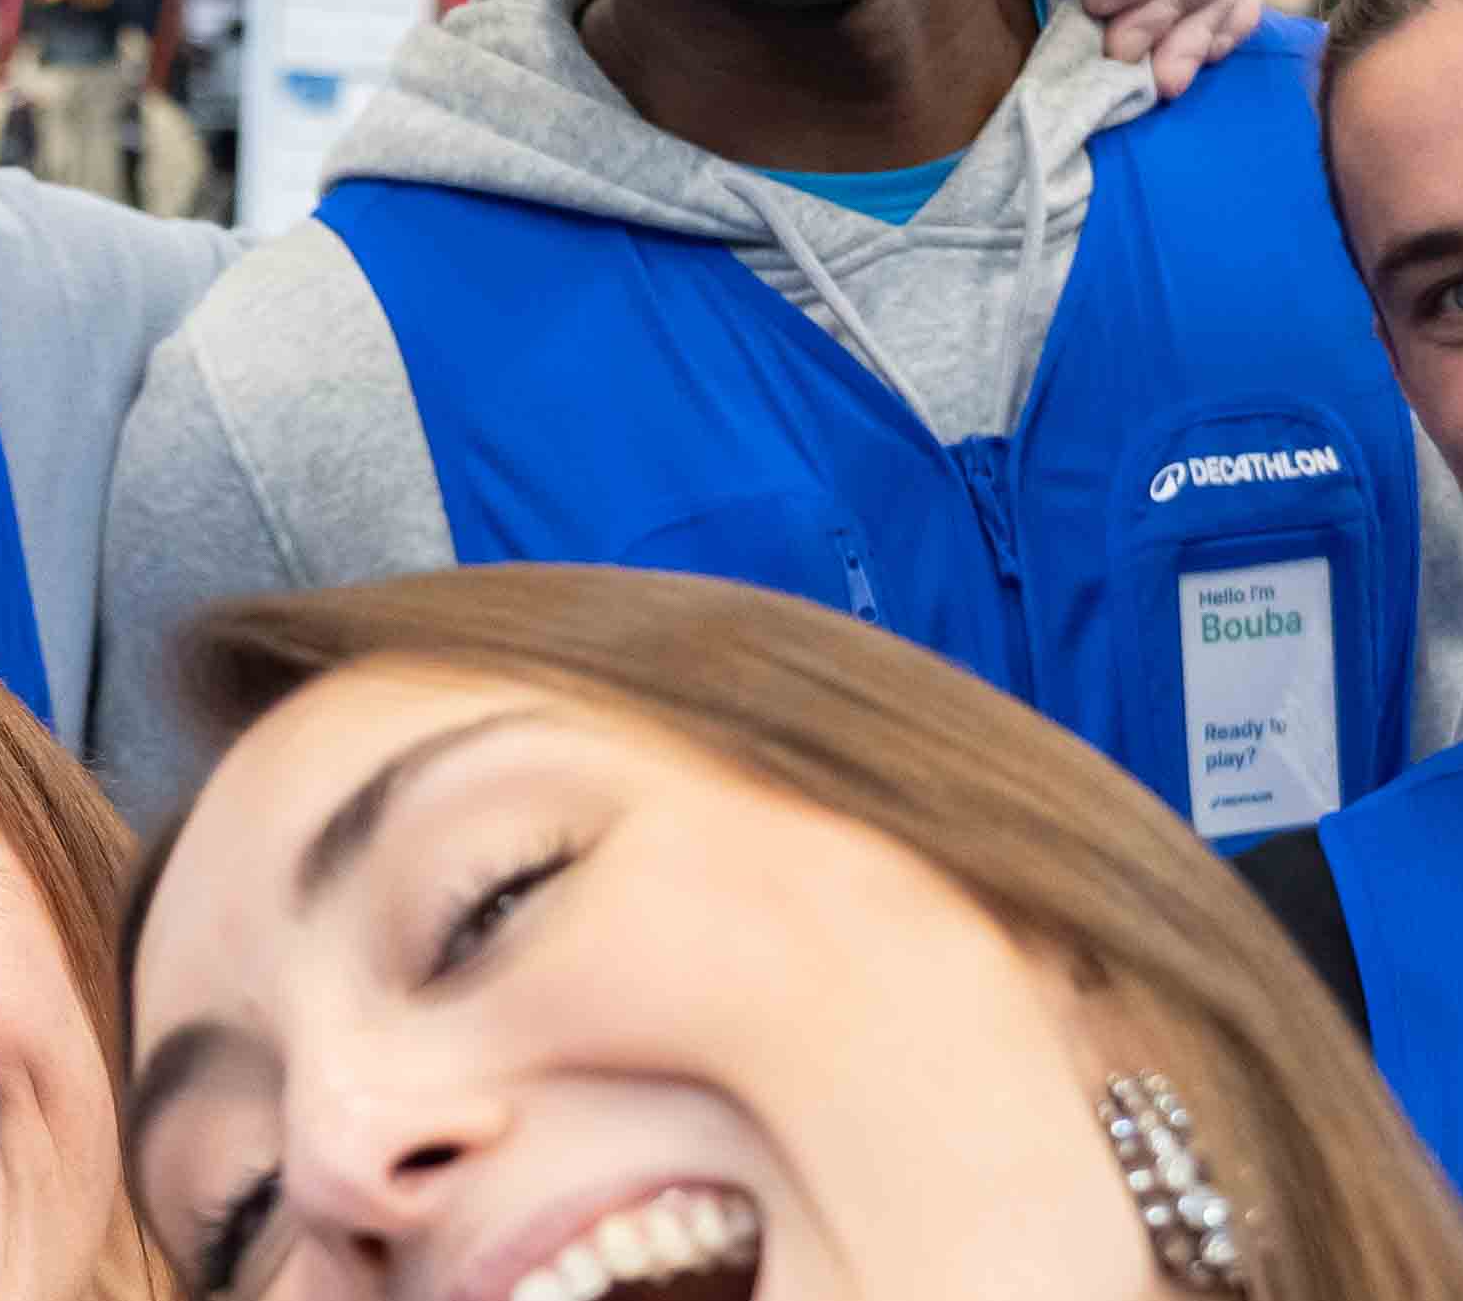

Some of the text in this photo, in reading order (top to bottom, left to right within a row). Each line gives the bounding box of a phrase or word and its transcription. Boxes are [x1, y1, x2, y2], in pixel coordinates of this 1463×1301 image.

[1187, 445, 1340, 487] DECATHLON
[1199, 587, 1245, 607] Hello
[1201, 608, 1302, 643] Bouba
[1204, 719, 1264, 742] Ready
[1205, 747, 1256, 773] play?
